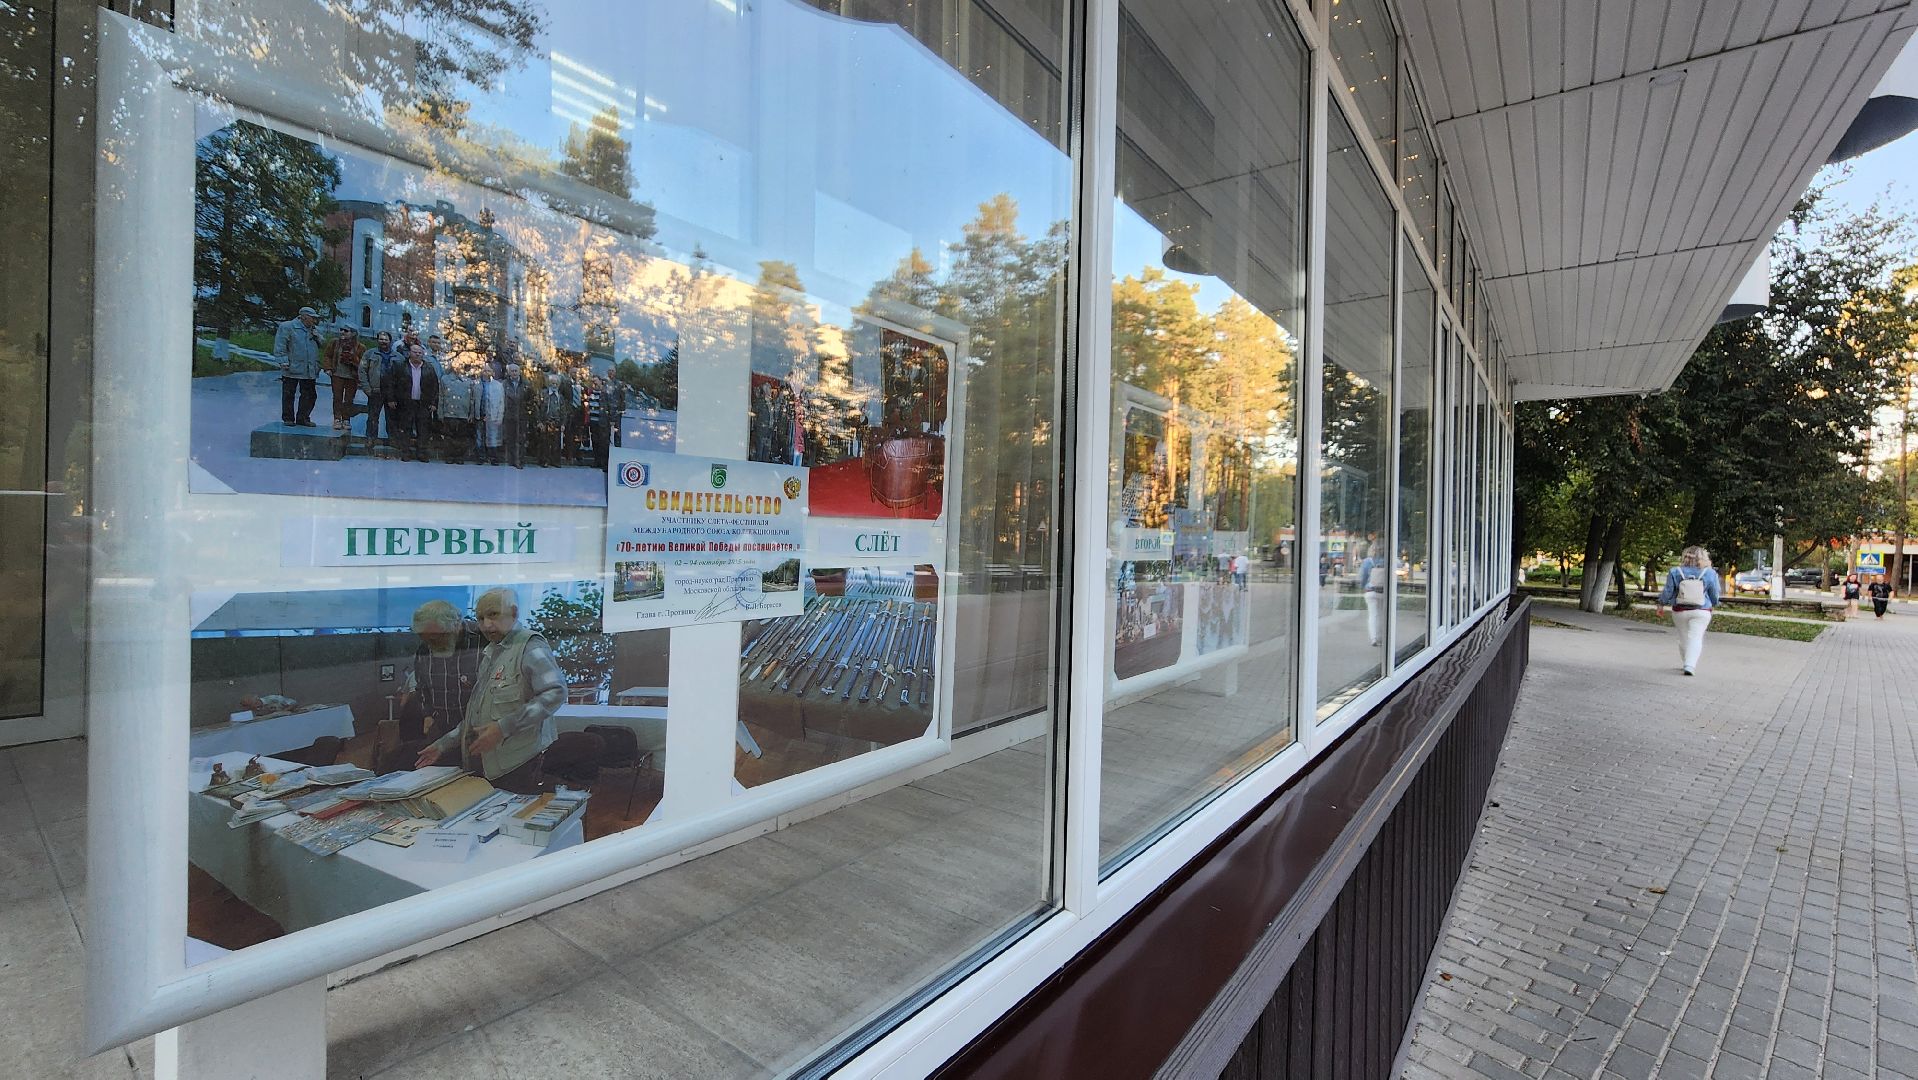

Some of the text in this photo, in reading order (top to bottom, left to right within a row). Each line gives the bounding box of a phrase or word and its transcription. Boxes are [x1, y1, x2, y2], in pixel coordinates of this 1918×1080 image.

[645, 488, 782, 515] СВИДЕТЕЛЬСТВО
[661, 516, 706, 525] УЧАСТНИКУ
[343, 522, 538, 556] ПЕРВЫЙ
[632, 527, 705, 535] МЕЖДУНАРОДНОГО
[668, 540, 706, 552] Великой
[709, 541, 740, 553] Победы
[855, 530, 901, 552] СЛЁТ
